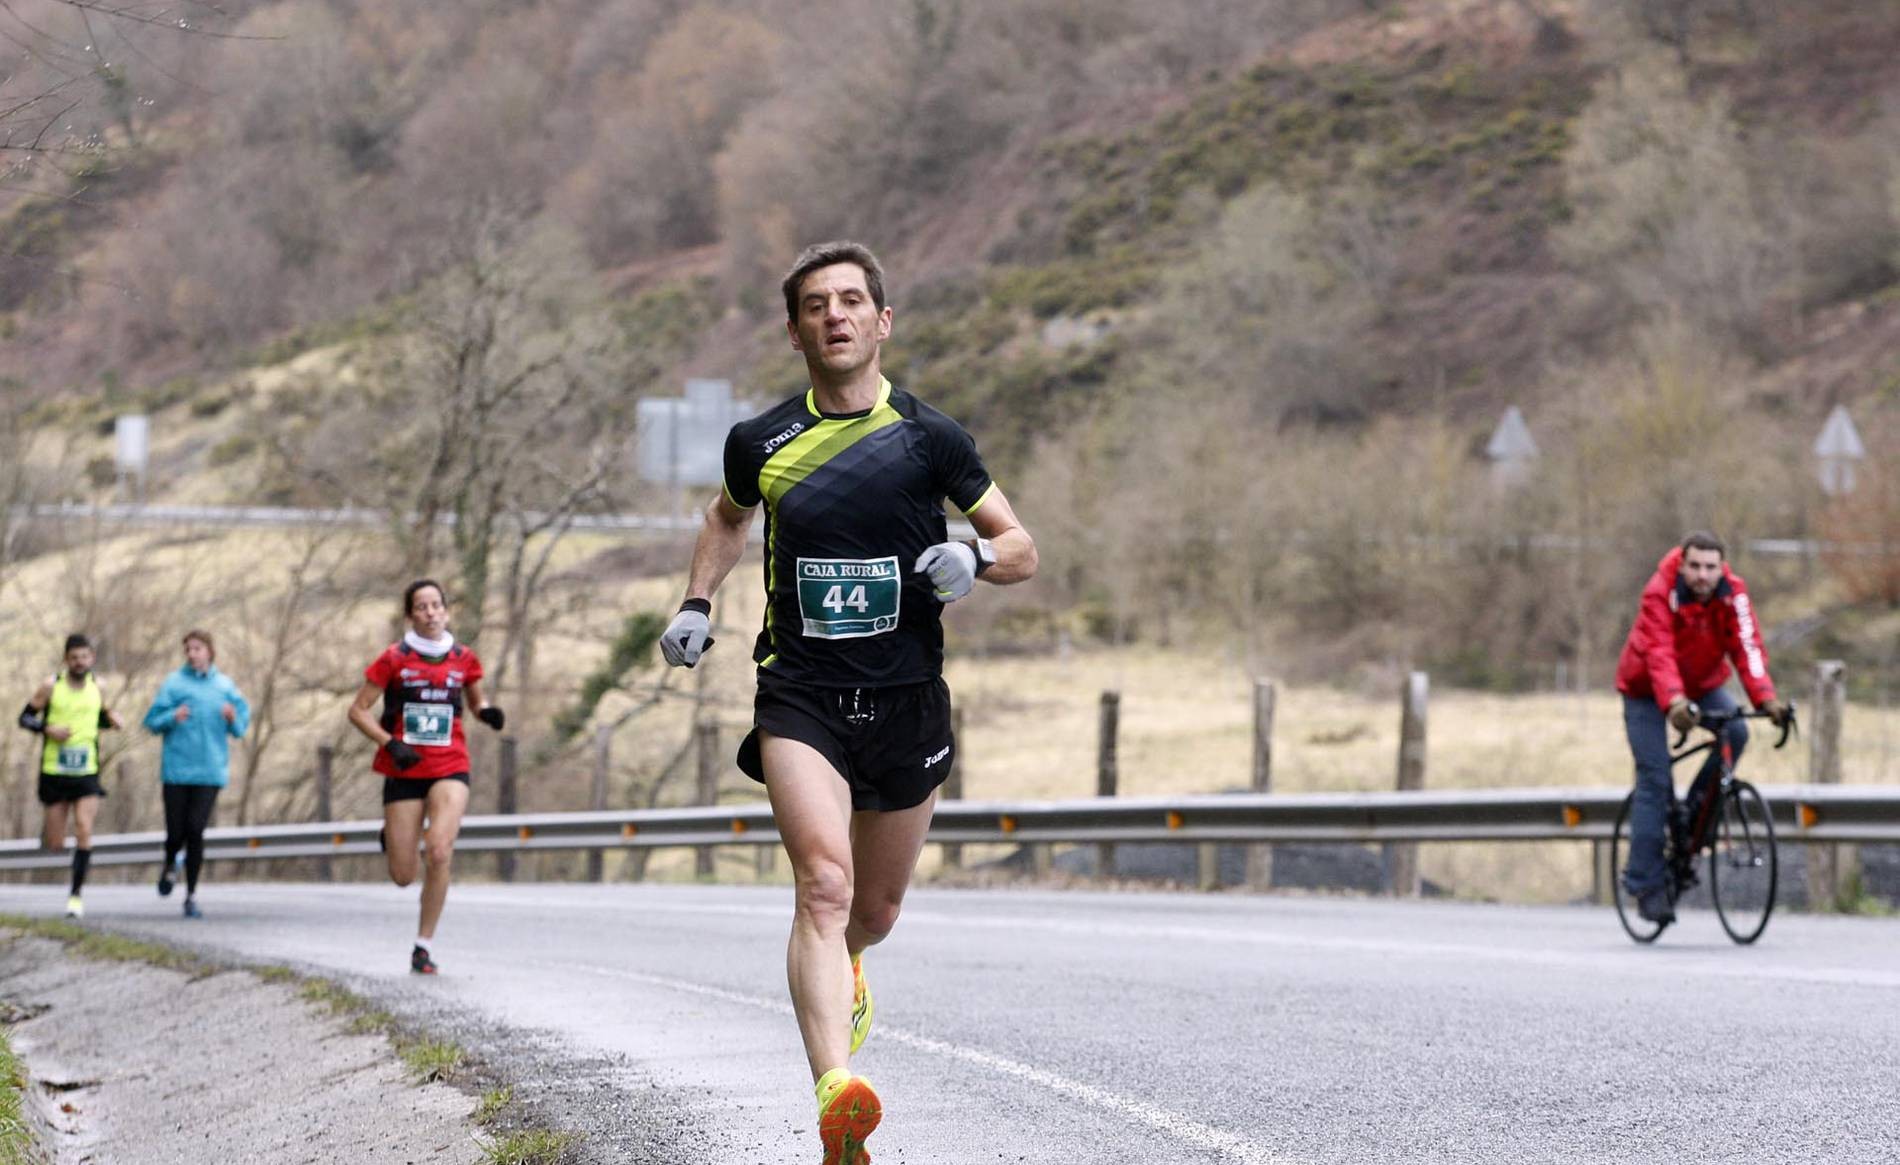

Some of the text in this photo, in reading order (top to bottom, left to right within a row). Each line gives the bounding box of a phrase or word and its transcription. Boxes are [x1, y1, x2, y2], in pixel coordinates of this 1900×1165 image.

[763, 422, 805, 454] Joma
[804, 563, 890, 578] CAJA RURAL
[822, 585, 869, 614] 44
